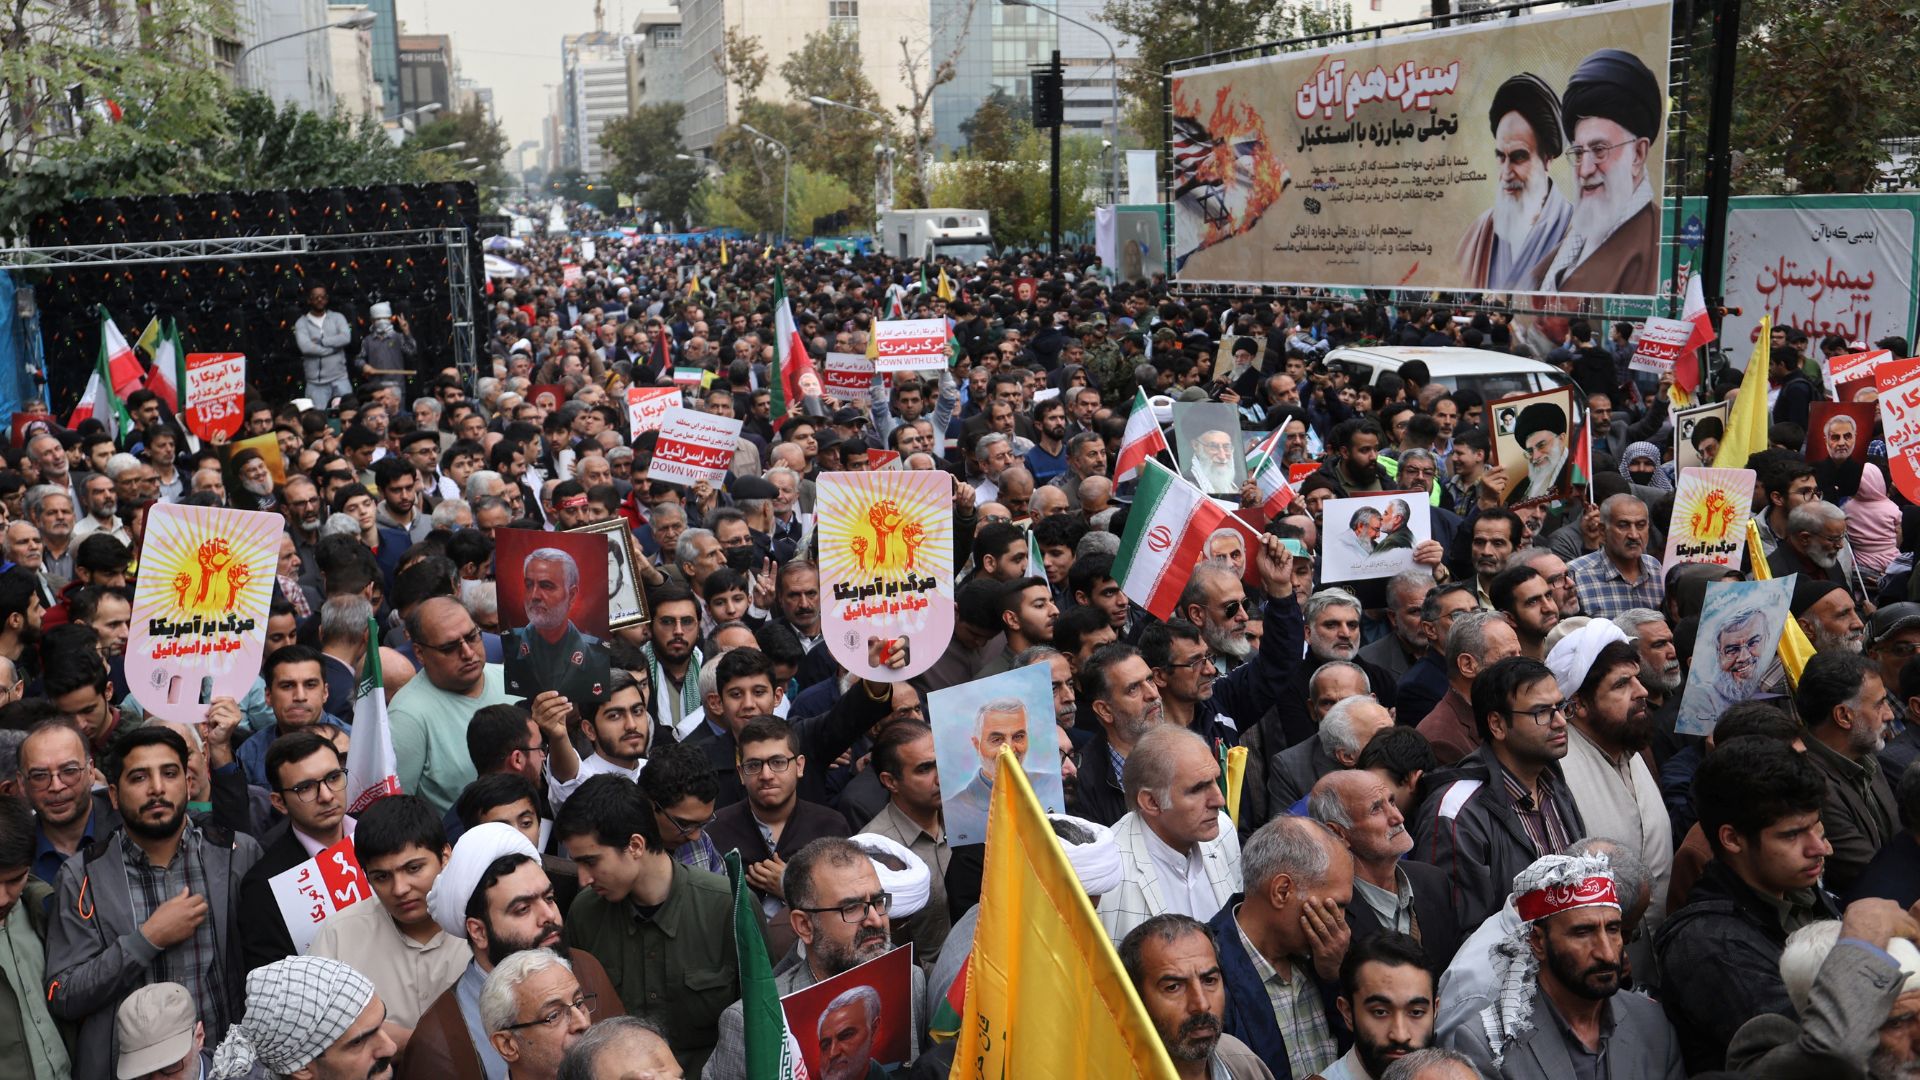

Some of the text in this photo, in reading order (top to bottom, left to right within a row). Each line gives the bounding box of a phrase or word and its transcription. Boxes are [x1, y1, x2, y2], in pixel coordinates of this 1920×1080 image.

[1296, 59, 1459, 121] سیزدهم آبان
[1297, 122, 1355, 152] استکبار
[1356, 122, 1366, 148] با
[1368, 118, 1414, 147] مبارزه
[1401, 158, 1422, 170] مواجه
[1453, 155, 1468, 166] شما
[1380, 226, 1412, 239] سیزدهم
[1811, 223, 1825, 242] آن
[1831, 226, 1848, 240] که
[1848, 230, 1874, 244] بمبی
[1757, 255, 1875, 302] بیمارستان
[906, 342, 920, 354] بر
[921, 338, 945, 352] مرگ
[1637, 341, 1673, 358] اسرائیل
[231, 364, 241, 373] ما
[903, 357, 923, 366] WITH
[190, 374, 200, 389] را
[200, 363, 228, 383] آمریکا
[196, 400, 241, 423] USA
[641, 397, 667, 417] آمریکا
[669, 398, 679, 407] ما
[1886, 399, 1904, 421] را
[633, 410, 643, 423] را
[655, 441, 705, 463] اسرائیل
[700, 454, 716, 467] بر
[715, 450, 732, 468] مرگ
[651, 460, 685, 476] DOWN
[686, 468, 708, 479] WITH
[1676, 540, 1737, 557] مرگ بر آمریکا
[833, 572, 937, 602] مرگ بر آمریکا
[843, 594, 929, 621] مرگ بر اسرائیل
[149, 613, 254, 638] مرگ بر آمریکا
[152, 636, 241, 659] مرگ بر اسرائیل
[297, 868, 327, 923] ما آمریکا
